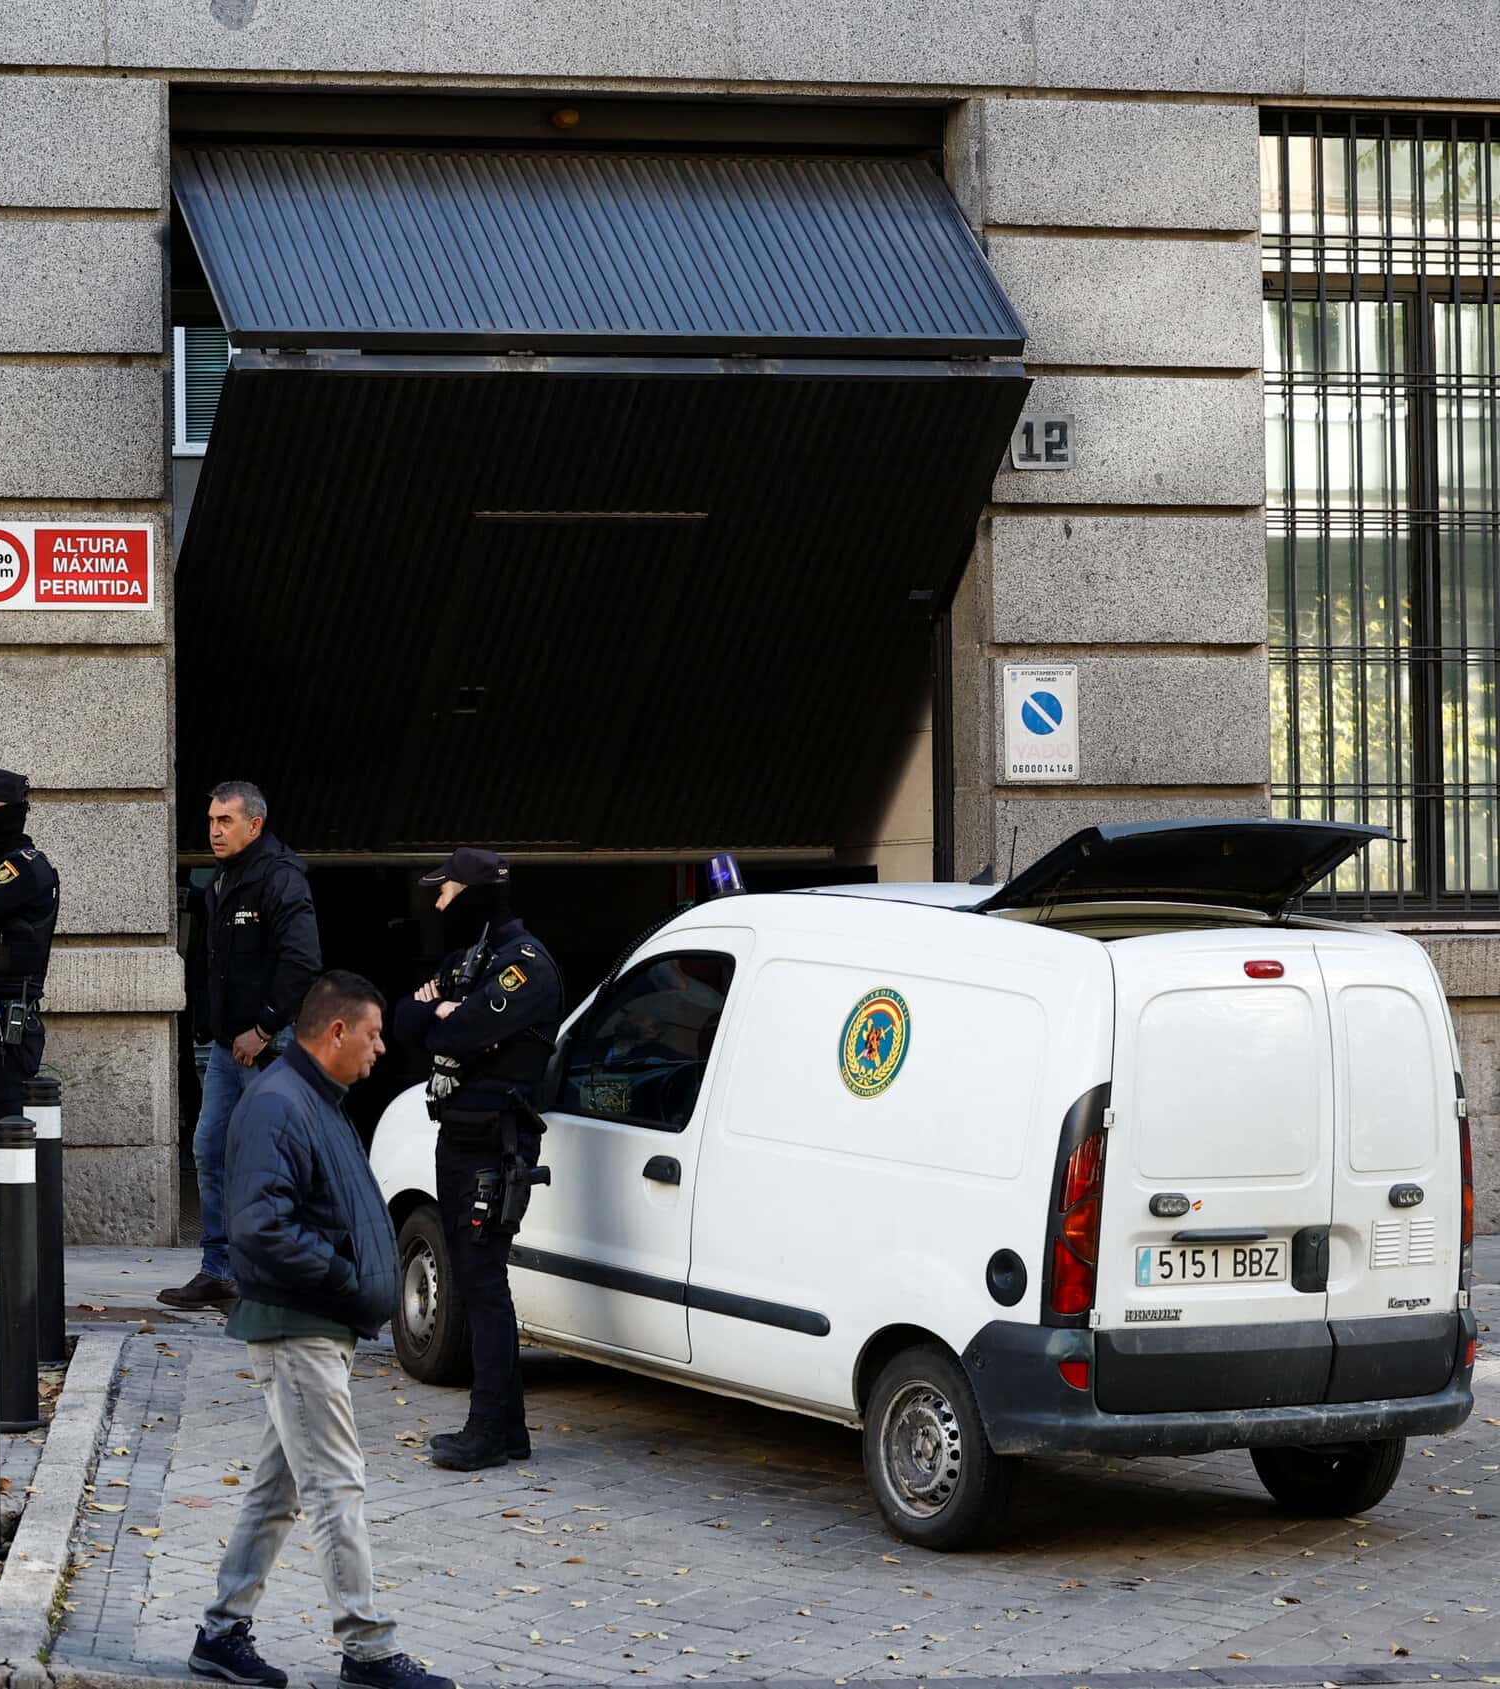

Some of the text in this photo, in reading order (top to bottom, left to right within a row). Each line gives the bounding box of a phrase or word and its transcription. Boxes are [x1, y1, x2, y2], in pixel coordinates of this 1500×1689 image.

[1018, 420, 1068, 462] 12
[53, 538, 128, 553] ALTURA
[53, 554, 128, 573] MÁXIMA
[0, 568, 13, 577] m
[40, 580, 142, 595] PERMITIDA
[1158, 1248, 1279, 1279] 5151 BBZ
